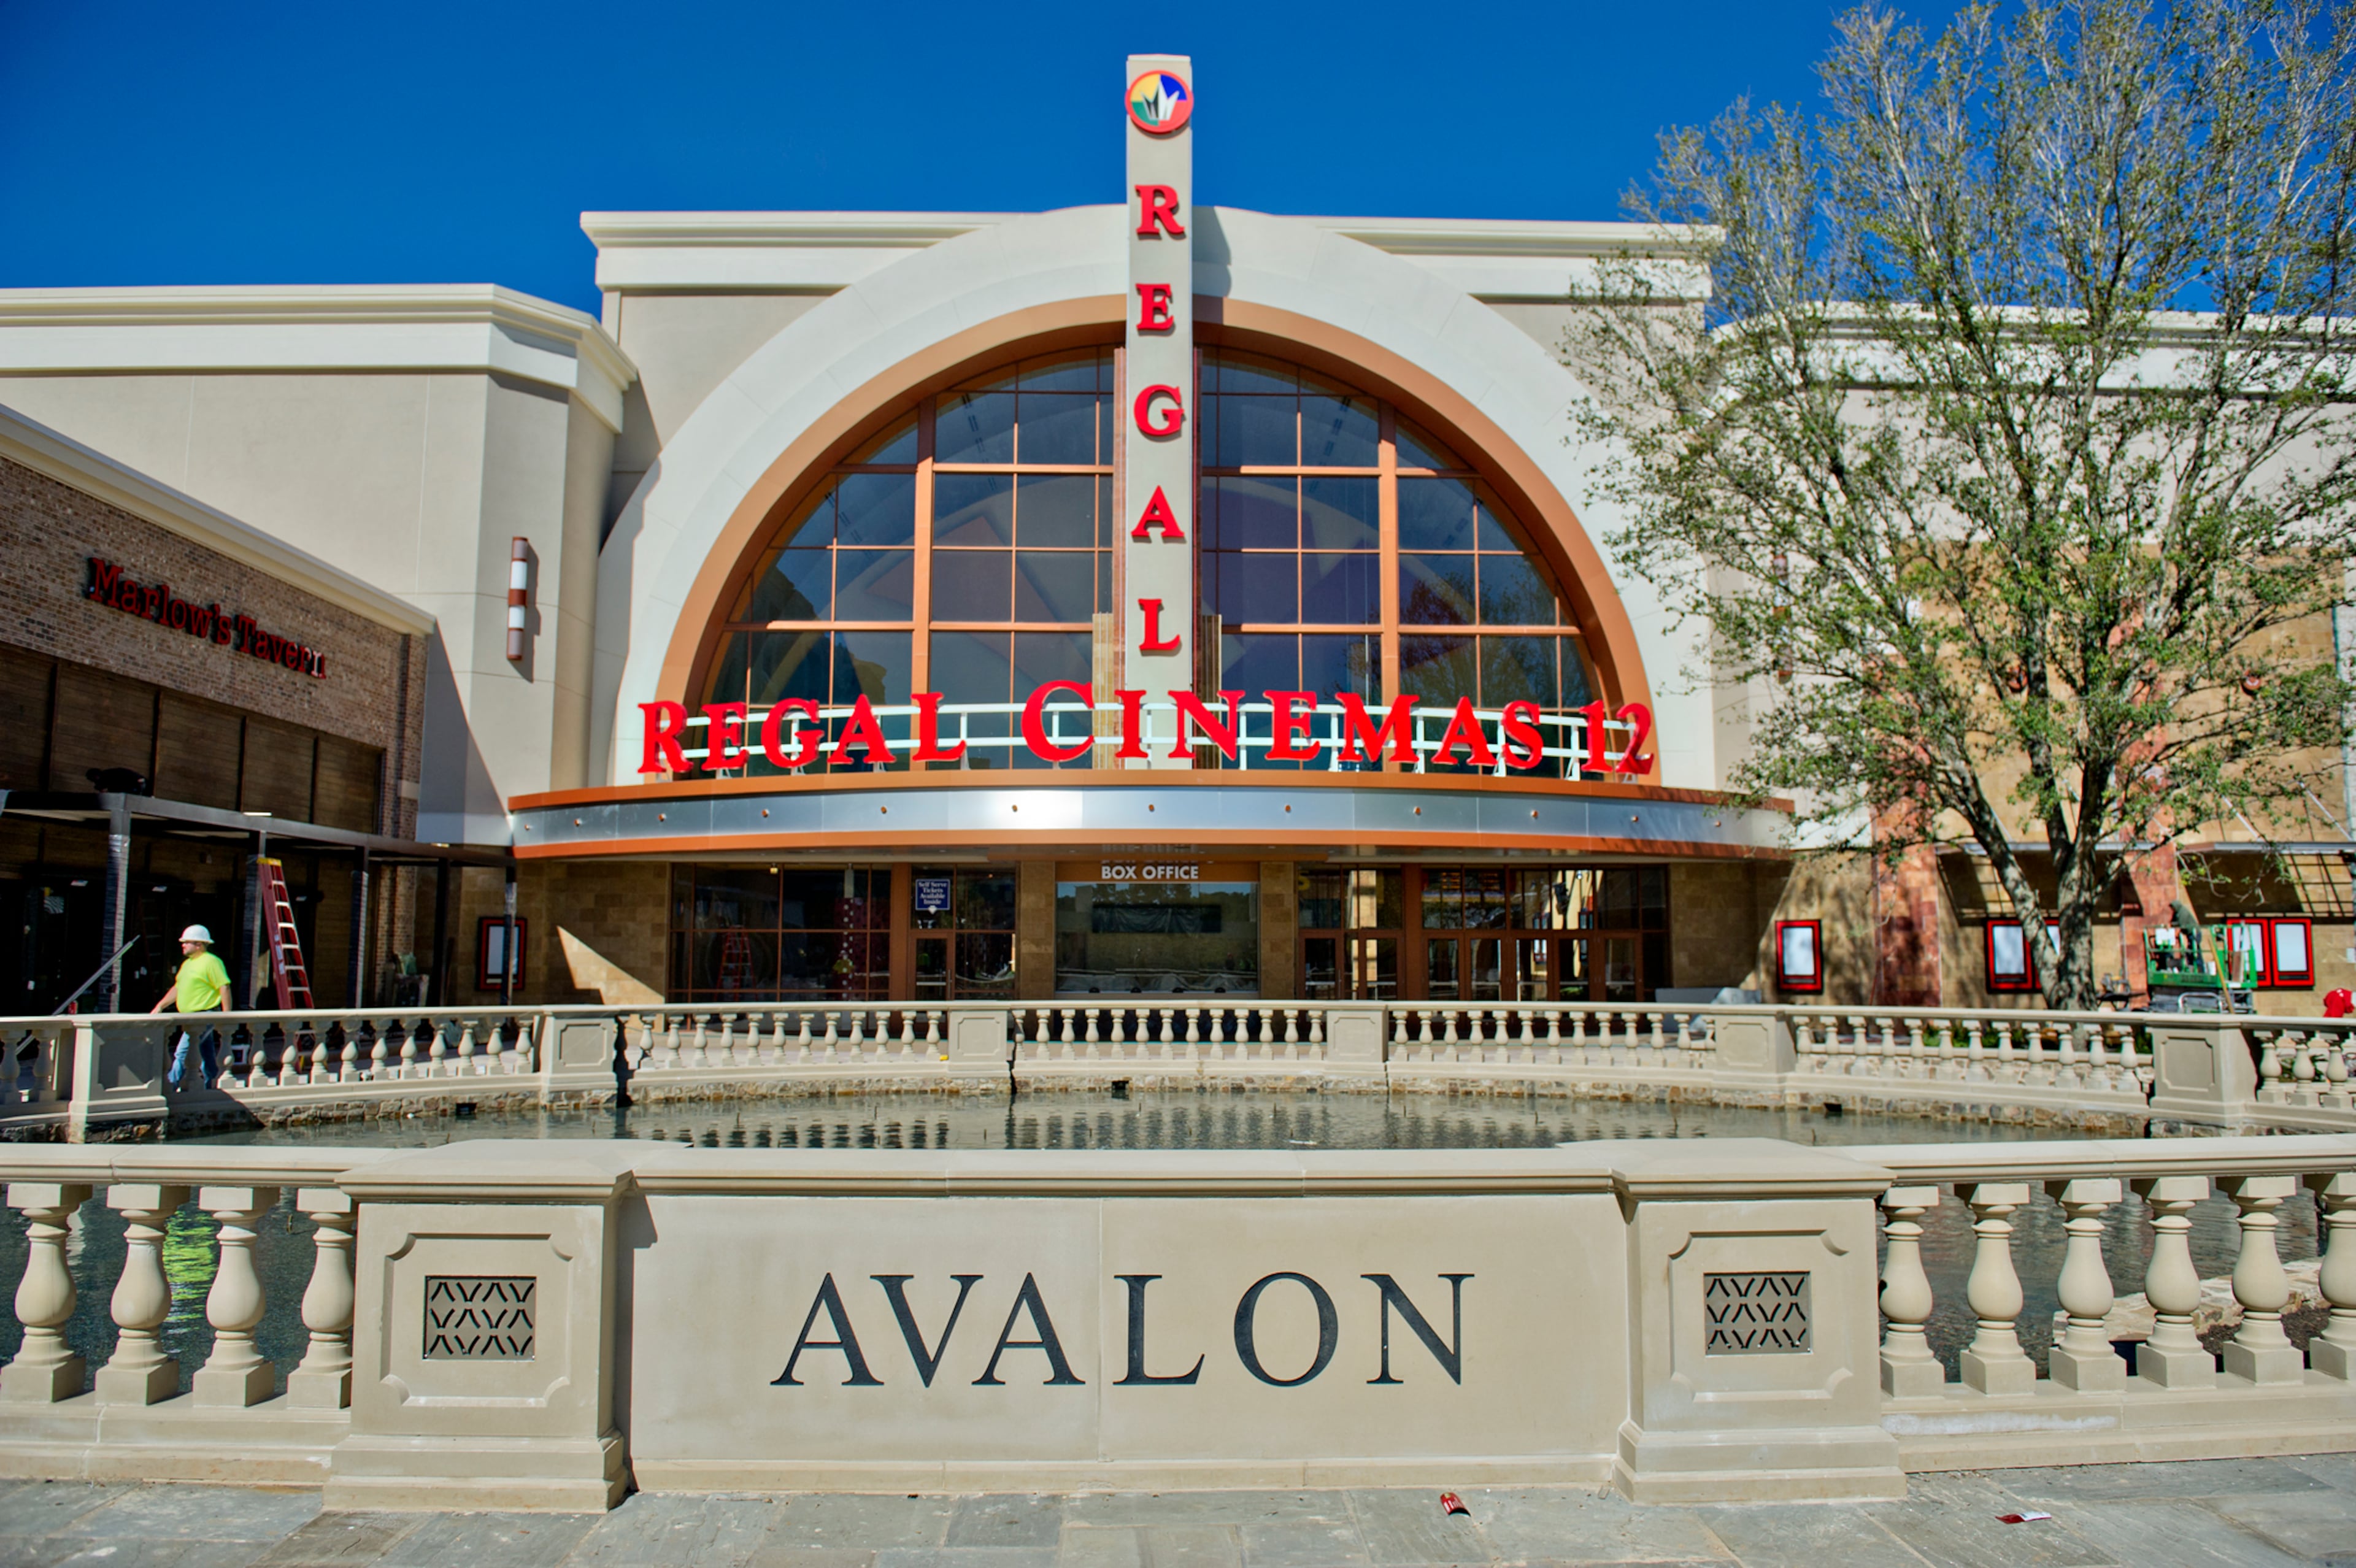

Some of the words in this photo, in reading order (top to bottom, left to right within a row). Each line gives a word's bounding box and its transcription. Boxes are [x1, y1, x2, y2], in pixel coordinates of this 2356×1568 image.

[1132, 185, 1185, 653] REGAL
[86, 558, 232, 645] Marlow's
[237, 613, 326, 680] Tavern
[637, 691, 968, 774] REGAL
[1021, 678, 1545, 770] CINEMAS
[1579, 699, 1655, 776] 12
[1101, 866, 1138, 880] BOX
[1142, 866, 1199, 880] OFFICE
[770, 1272, 1476, 1388] AVALON
